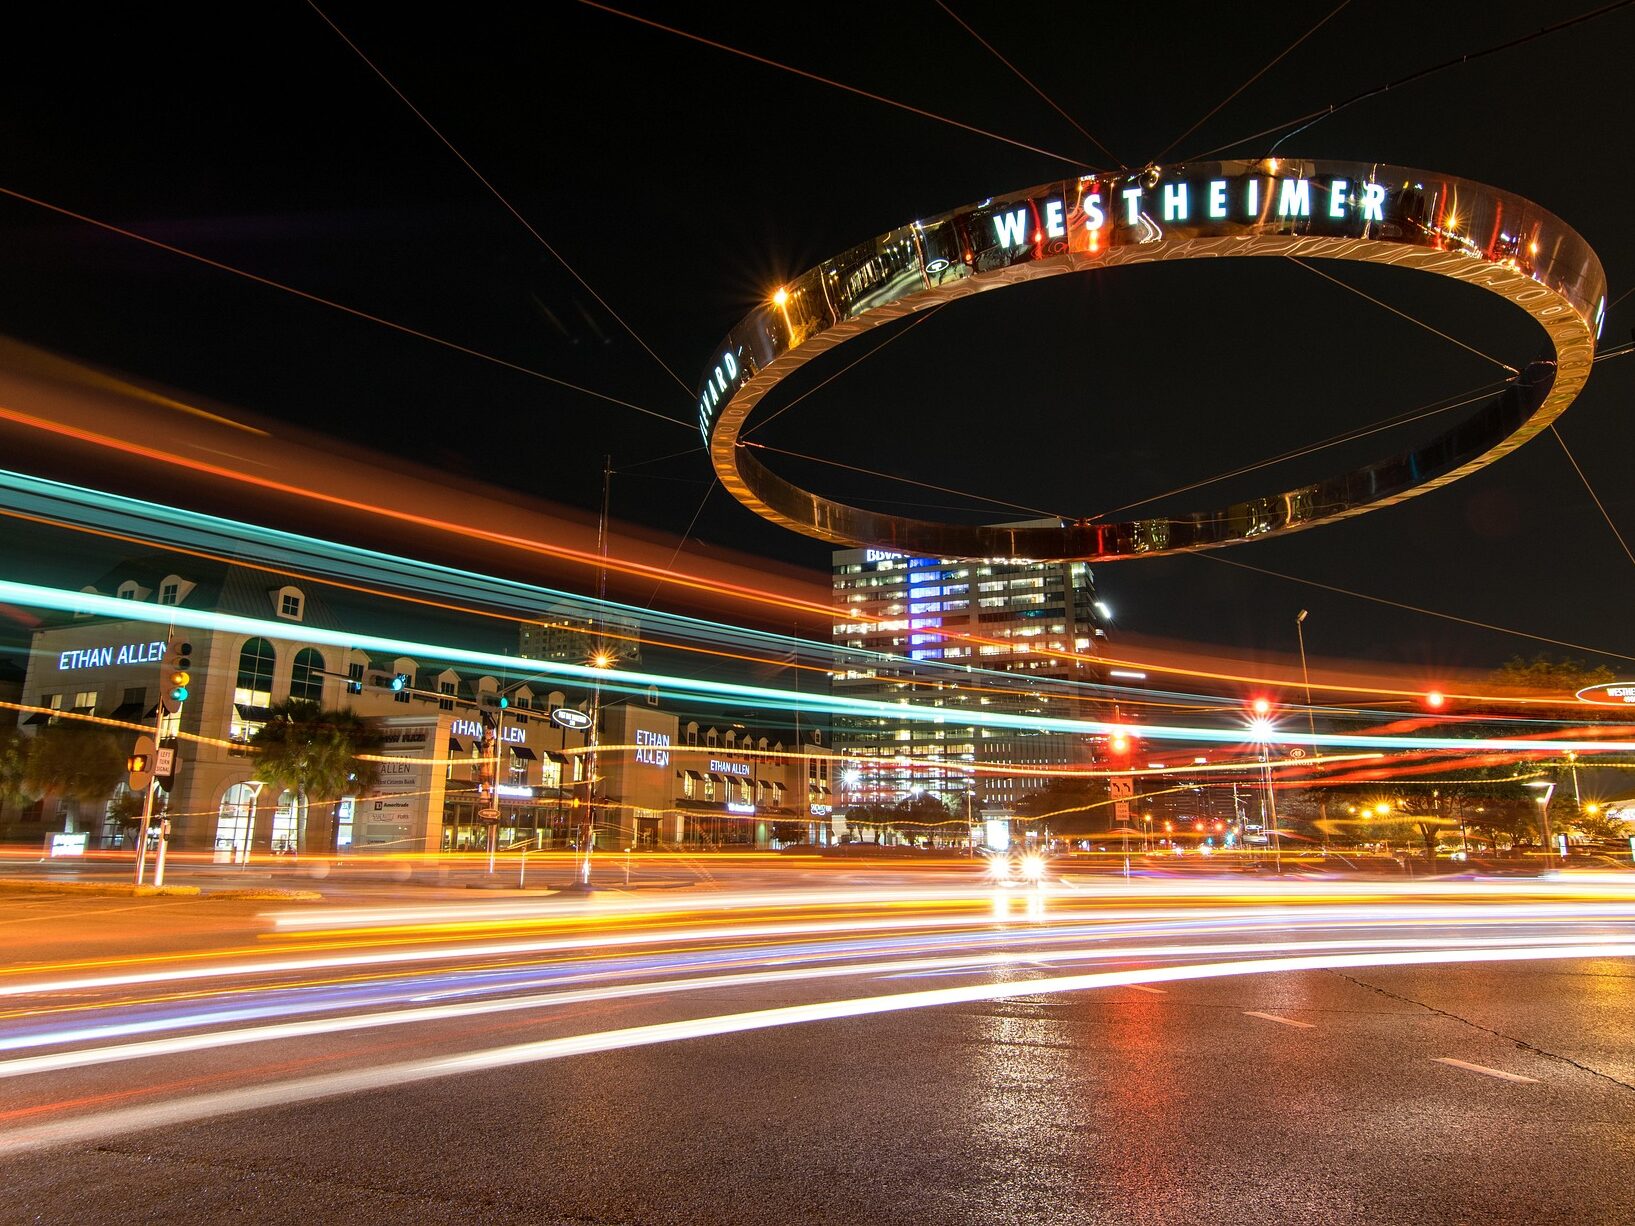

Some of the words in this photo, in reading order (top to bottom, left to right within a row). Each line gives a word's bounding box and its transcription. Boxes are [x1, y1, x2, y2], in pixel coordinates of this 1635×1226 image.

[993, 178, 1385, 249] WESTHEIMER
[59, 646, 114, 670] ETHAN
[117, 641, 167, 665] ALLEN
[451, 719, 483, 738] THAN
[636, 729, 670, 748] ETHAN
[635, 747, 670, 766] ALLEN
[380, 763, 412, 774] ALLEN
[710, 759, 731, 773] ETHAN
[731, 762, 750, 776] ALLEN
